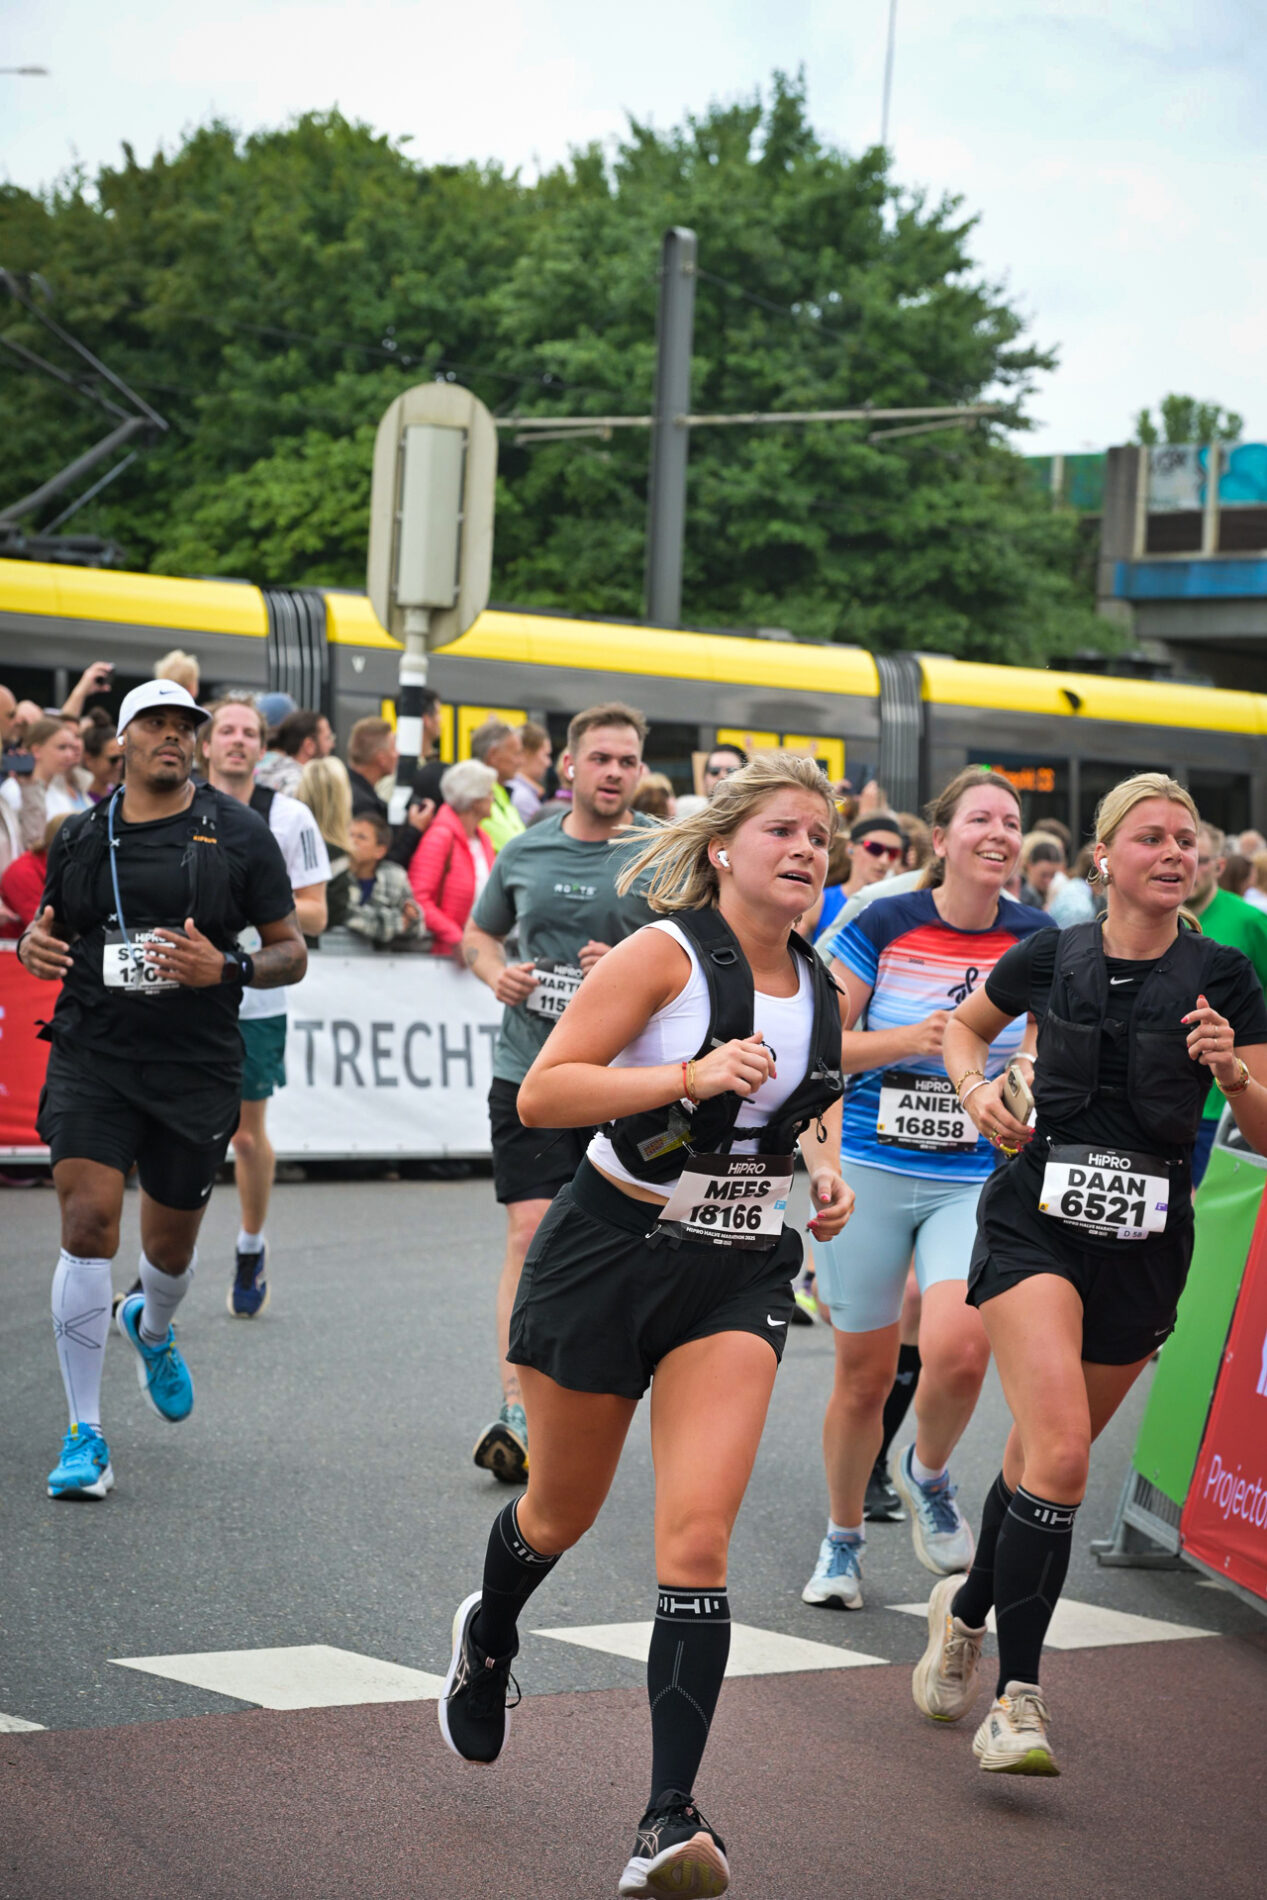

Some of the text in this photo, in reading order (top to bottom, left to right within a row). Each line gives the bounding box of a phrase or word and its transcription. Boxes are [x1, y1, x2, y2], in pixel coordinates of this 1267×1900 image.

[537, 975, 581, 993] MART
[541, 995, 571, 1012] 115
[294, 1020, 500, 1087] TRECHT
[898, 1094, 964, 1114] ANIEK
[895, 1116, 964, 1139] 16858
[727, 1162, 766, 1175] HiPRO
[1088, 1153, 1131, 1169] HiPRO
[704, 1180, 771, 1200] MEES
[1067, 1168, 1147, 1197] DAAN
[689, 1203, 763, 1230] 18166
[1060, 1189, 1147, 1228] 6521
[1123, 1230, 1131, 1238] D
[1203, 1454, 1267, 1530] Projecto
